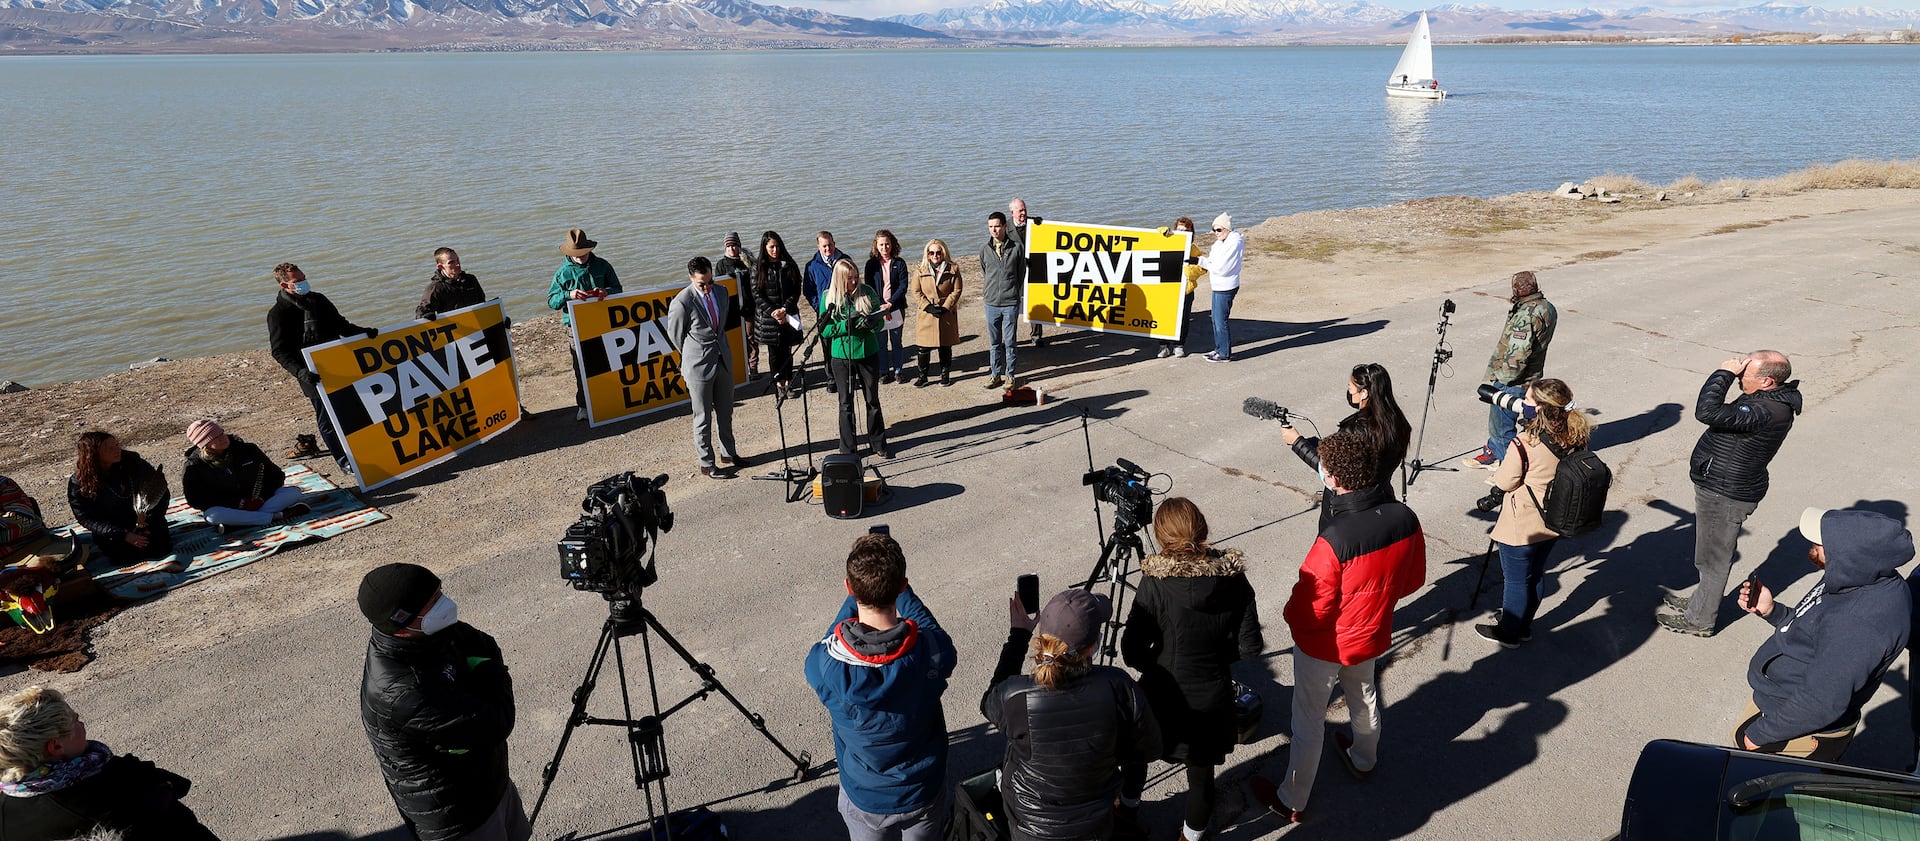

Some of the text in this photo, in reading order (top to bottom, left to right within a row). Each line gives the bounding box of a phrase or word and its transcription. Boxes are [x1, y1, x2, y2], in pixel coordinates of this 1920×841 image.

[1055, 231, 1139, 252] DON'T
[1046, 250, 1161, 284] PAVE
[607, 295, 676, 328] DON
[1053, 283, 1127, 306] UTAH
[1053, 301, 1158, 329] LAKE .ORG
[354, 323, 458, 374] DON'T
[601, 315, 674, 371] PA
[352, 330, 497, 425] PAVE
[619, 355, 682, 386] UTA
[623, 374, 689, 409] LAK
[382, 387, 475, 439] UTAH
[391, 409, 508, 465] LAKE .ORG
